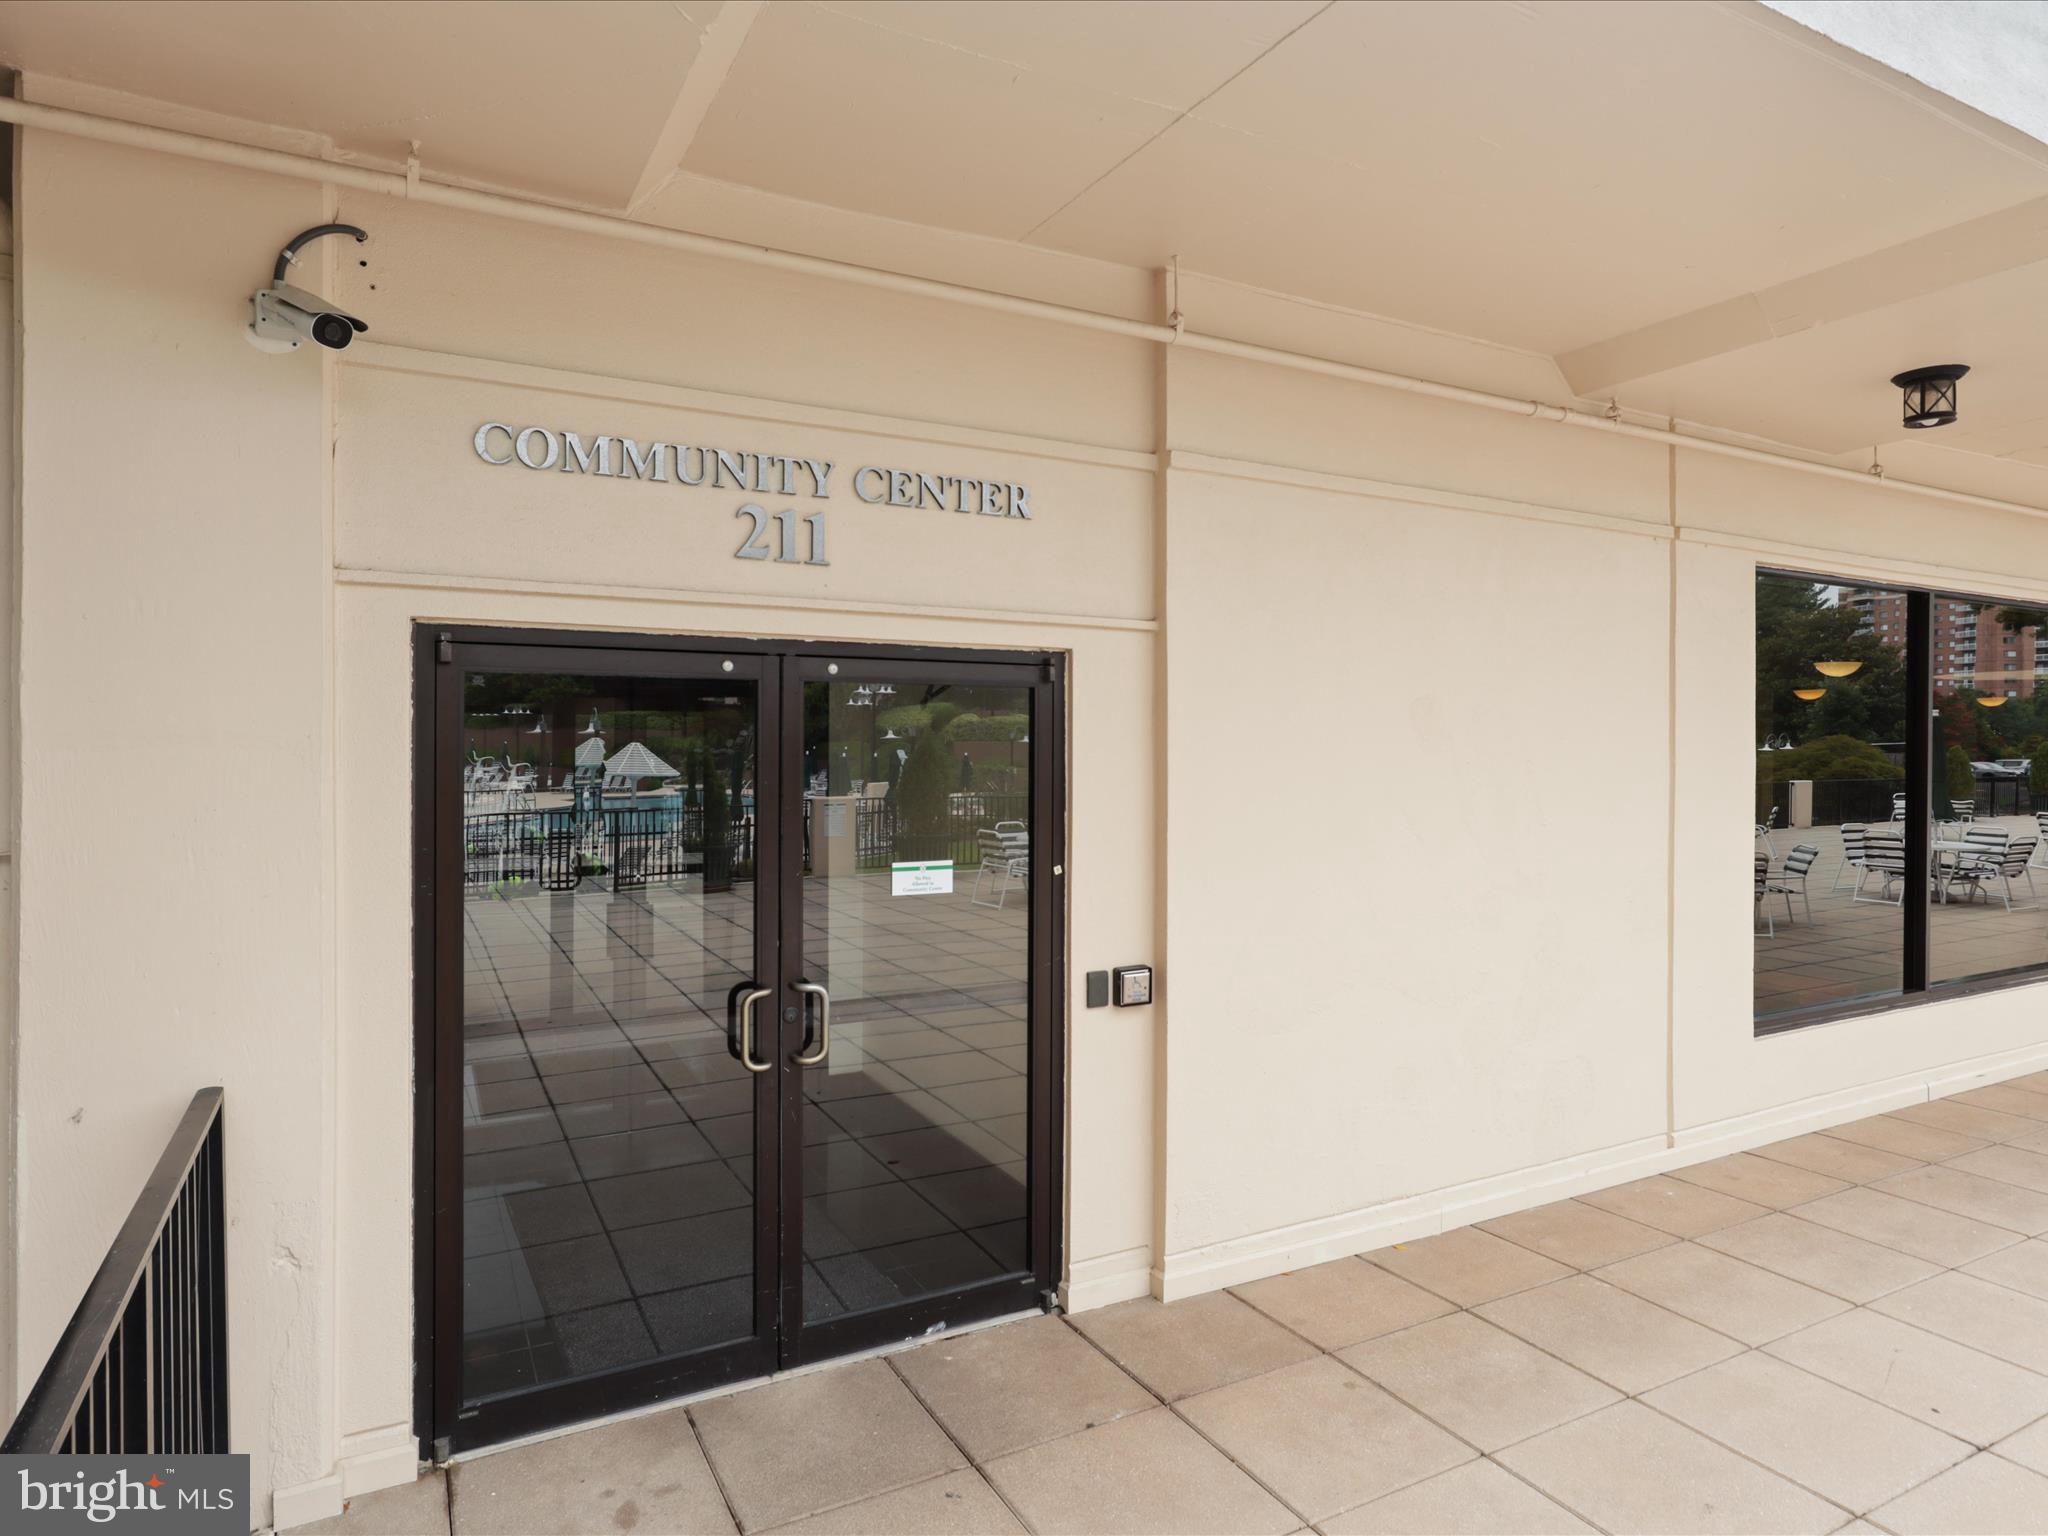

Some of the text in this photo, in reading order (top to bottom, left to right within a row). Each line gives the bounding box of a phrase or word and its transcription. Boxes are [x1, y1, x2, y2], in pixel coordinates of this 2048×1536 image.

[474, 422, 1031, 520] COMMUNITY CENTER
[734, 503, 830, 566] 211
